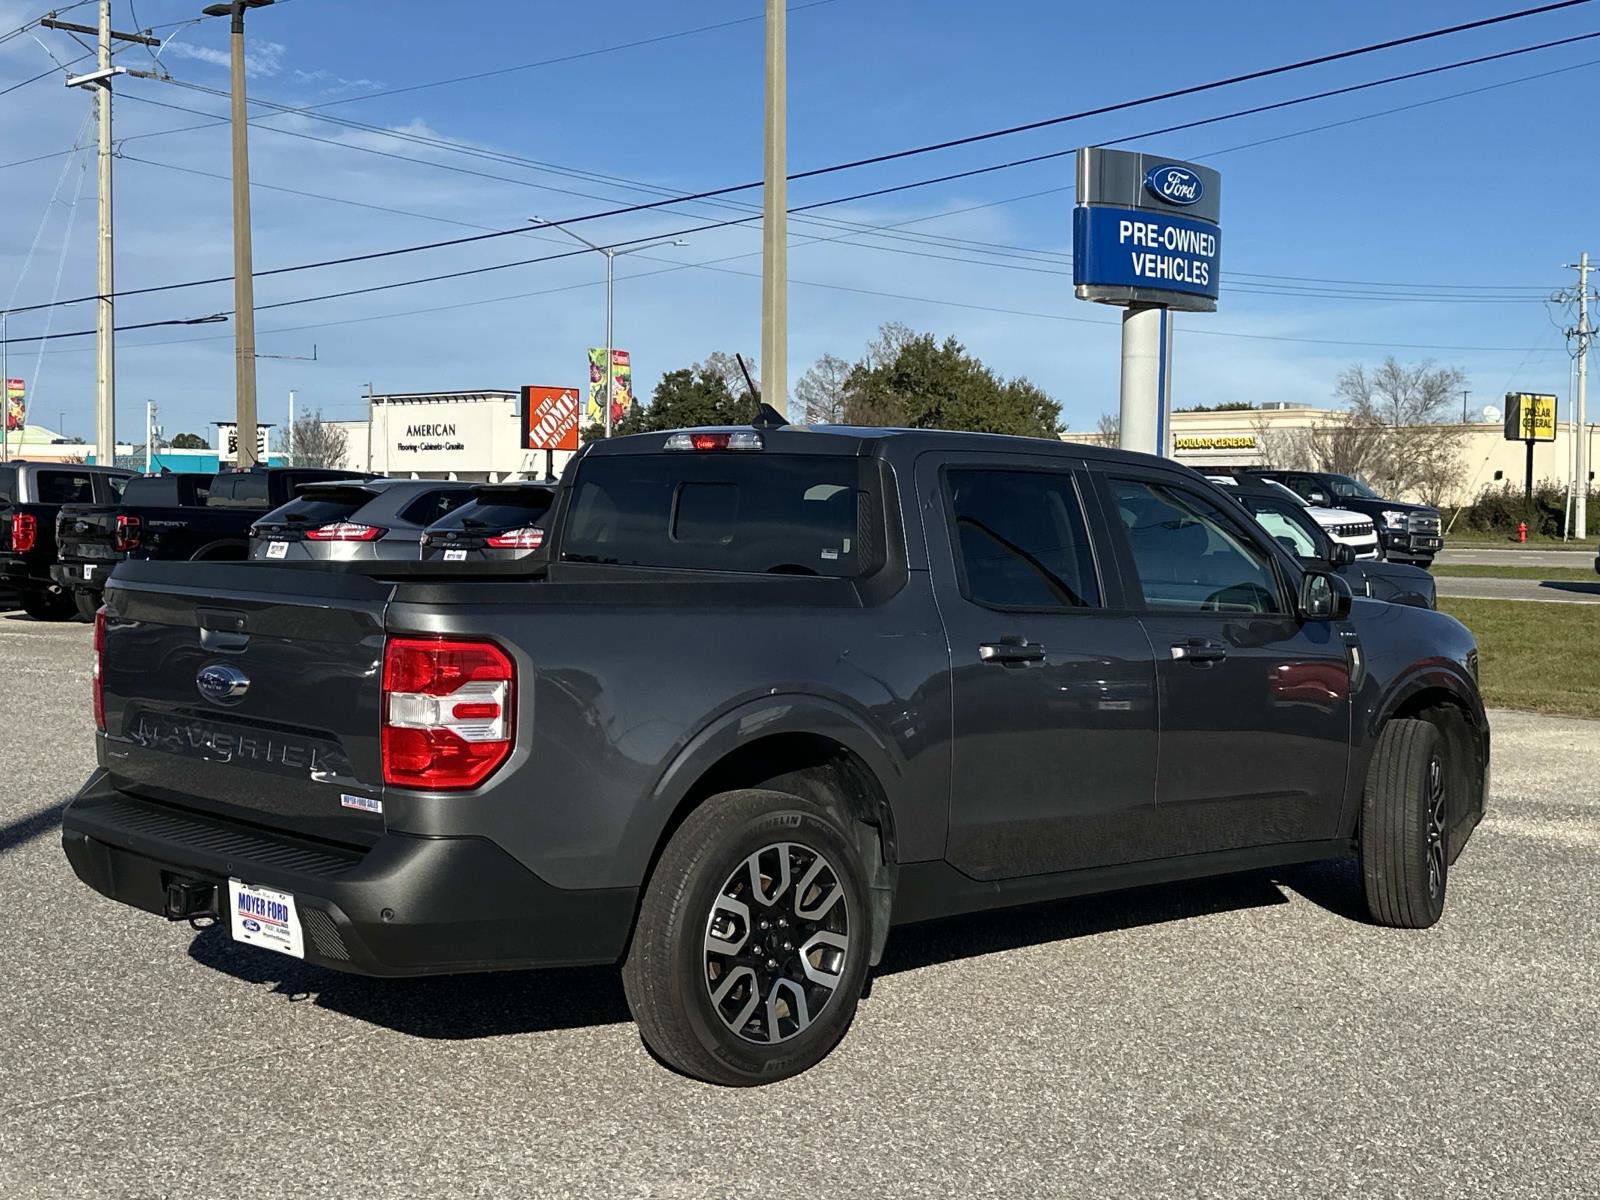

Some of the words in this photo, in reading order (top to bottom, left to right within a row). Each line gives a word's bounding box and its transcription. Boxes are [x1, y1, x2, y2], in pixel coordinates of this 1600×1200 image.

[1163, 171, 1196, 198] Ford
[1119, 220, 1216, 257] PRE-OWNED
[1131, 252, 1209, 286] VEHICLES
[535, 395, 555, 418] THE
[1524, 407, 1551, 417] DOLLAR
[405, 423, 456, 437] AMERICAN
[529, 390, 578, 448] HOME
[547, 412, 578, 449] DEPOT
[1522, 417, 1552, 428] GENERAL
[397, 442, 417, 453] Flooring
[420, 442, 443, 451] Cabinets
[445, 441, 465, 451] Granite
[1176, 437, 1213, 449] DOLLAR
[148, 519, 188, 527] SPORT
[238, 891, 265, 916] MOYER
[267, 900, 288, 922] FORD
